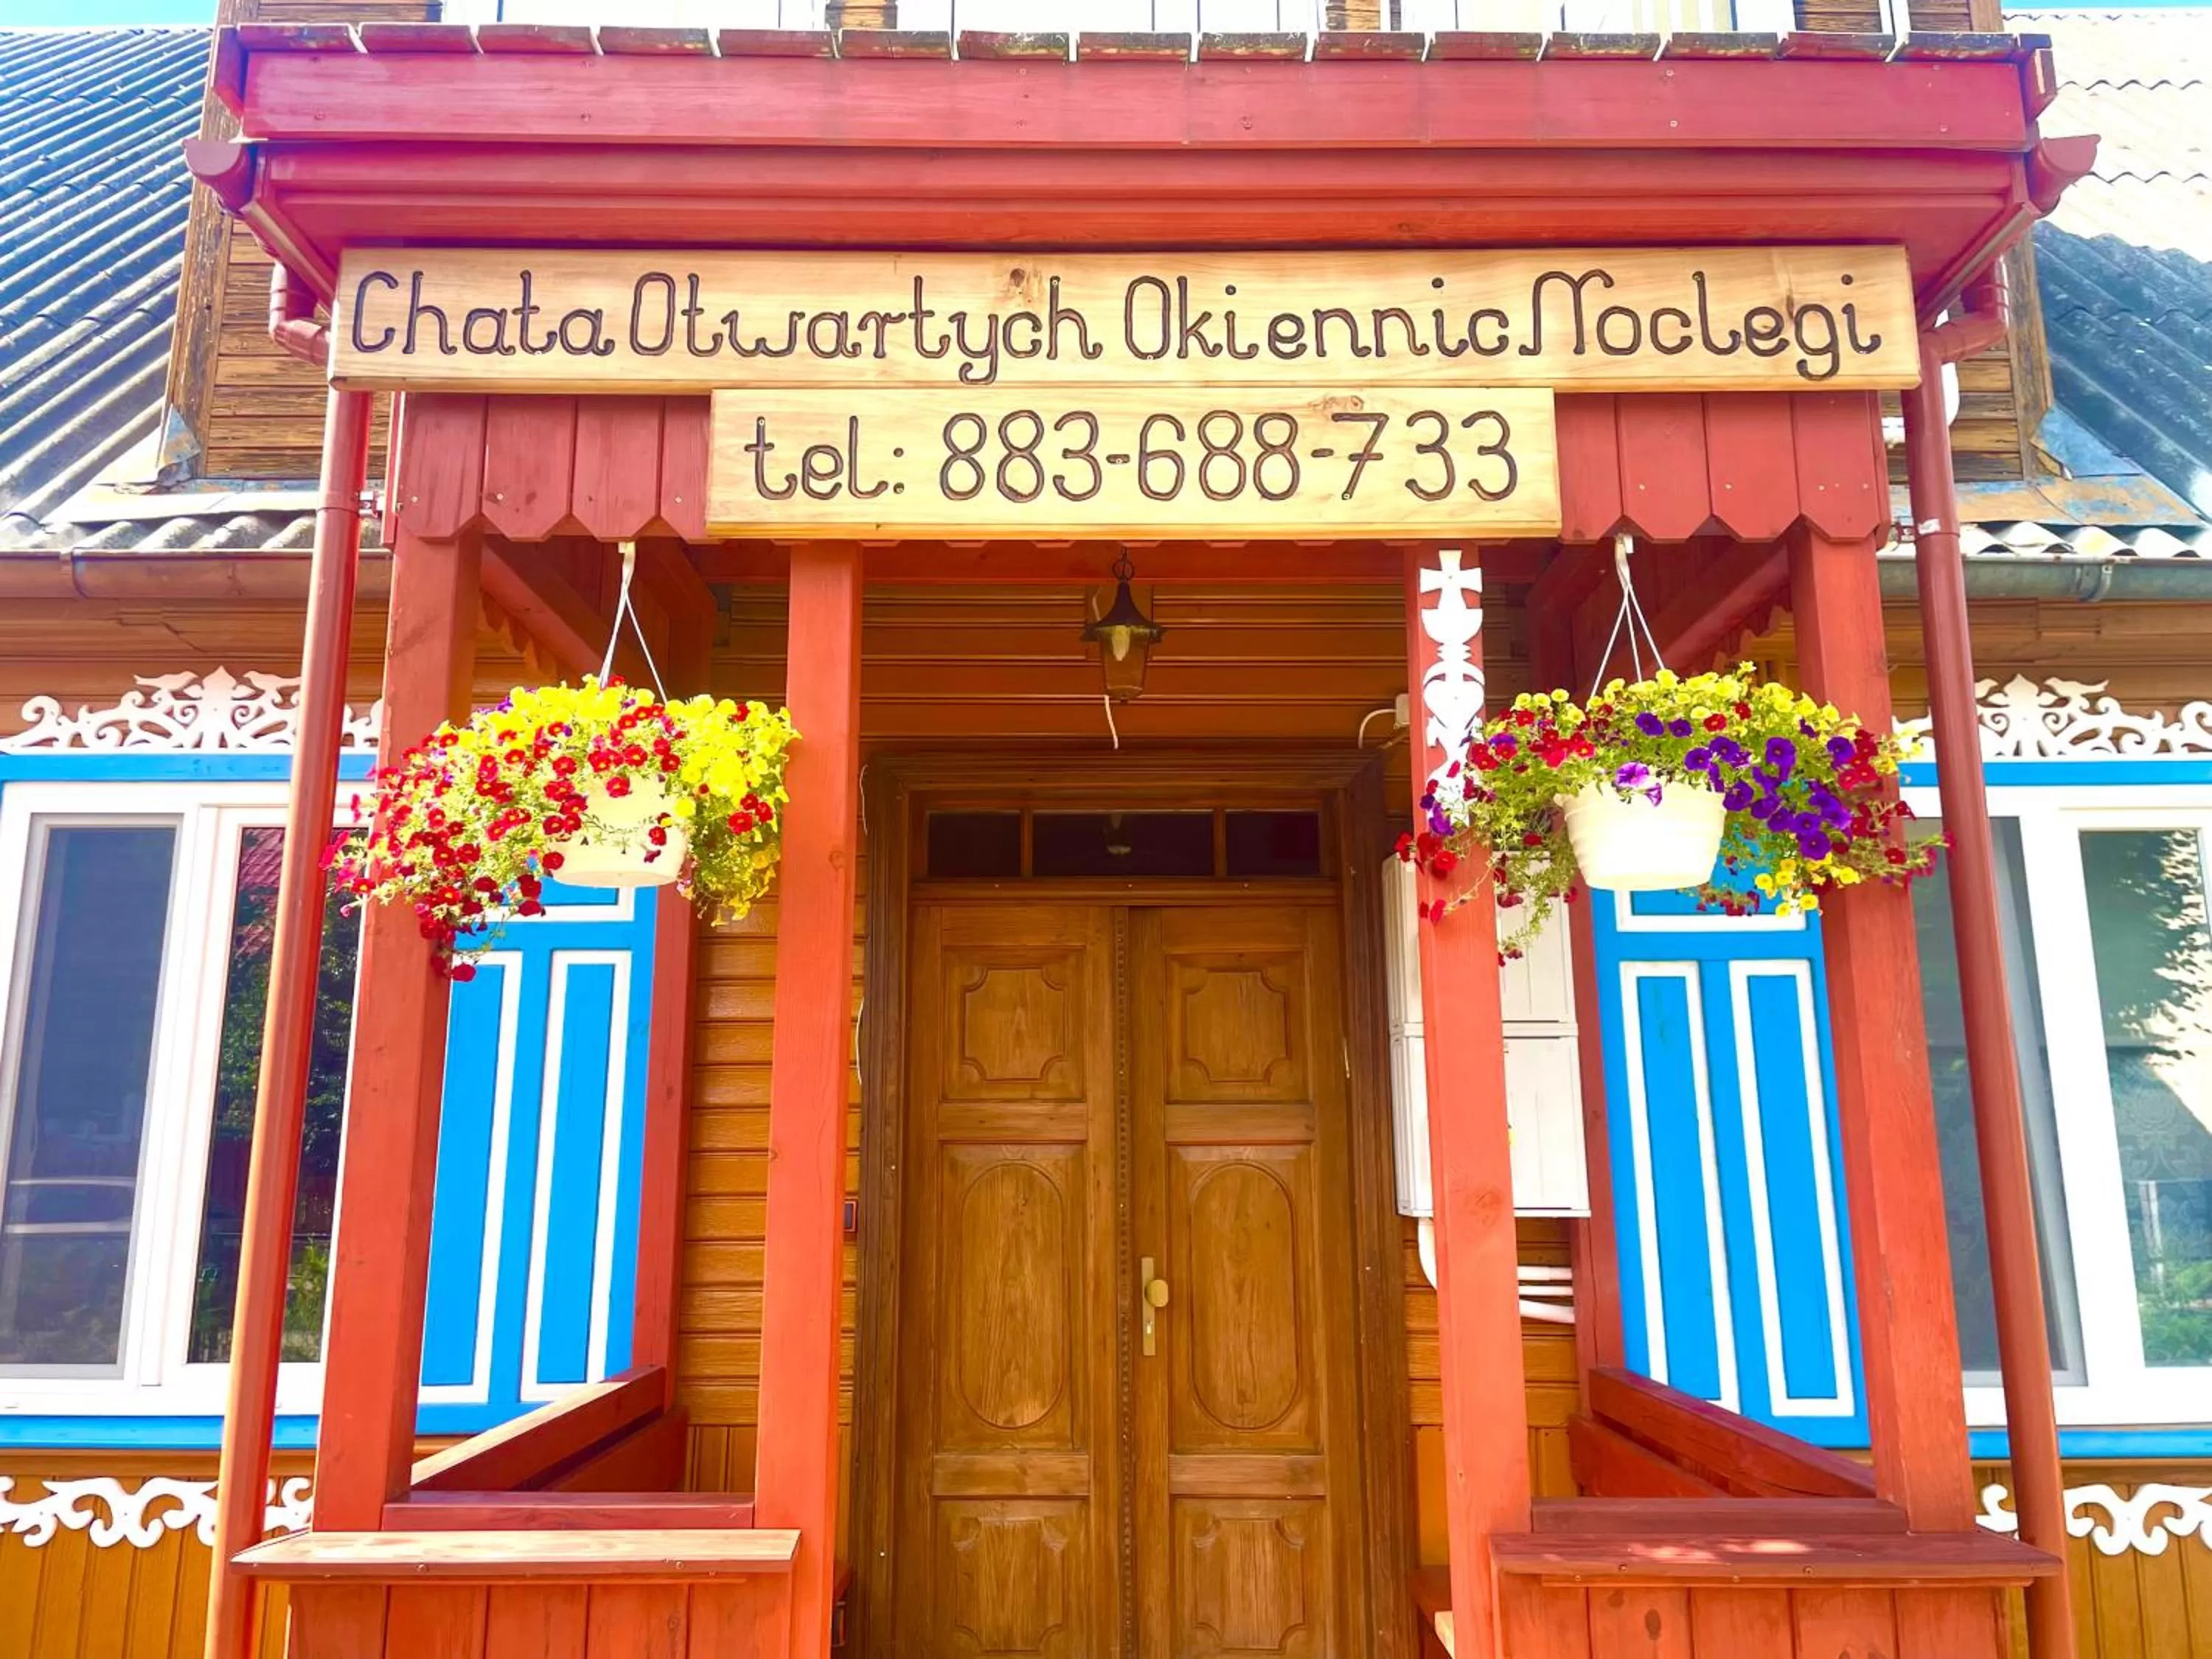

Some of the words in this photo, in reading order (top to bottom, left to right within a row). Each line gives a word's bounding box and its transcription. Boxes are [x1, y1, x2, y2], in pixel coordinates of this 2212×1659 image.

[350, 269, 616, 357] Chata
[629, 271, 1104, 386] Otwartych
[1124, 274, 1510, 361] Okiennic
[1517, 268, 1883, 380] Noclegi
[743, 415, 905, 501] tel:
[939, 408, 1519, 504] 883-688-733
